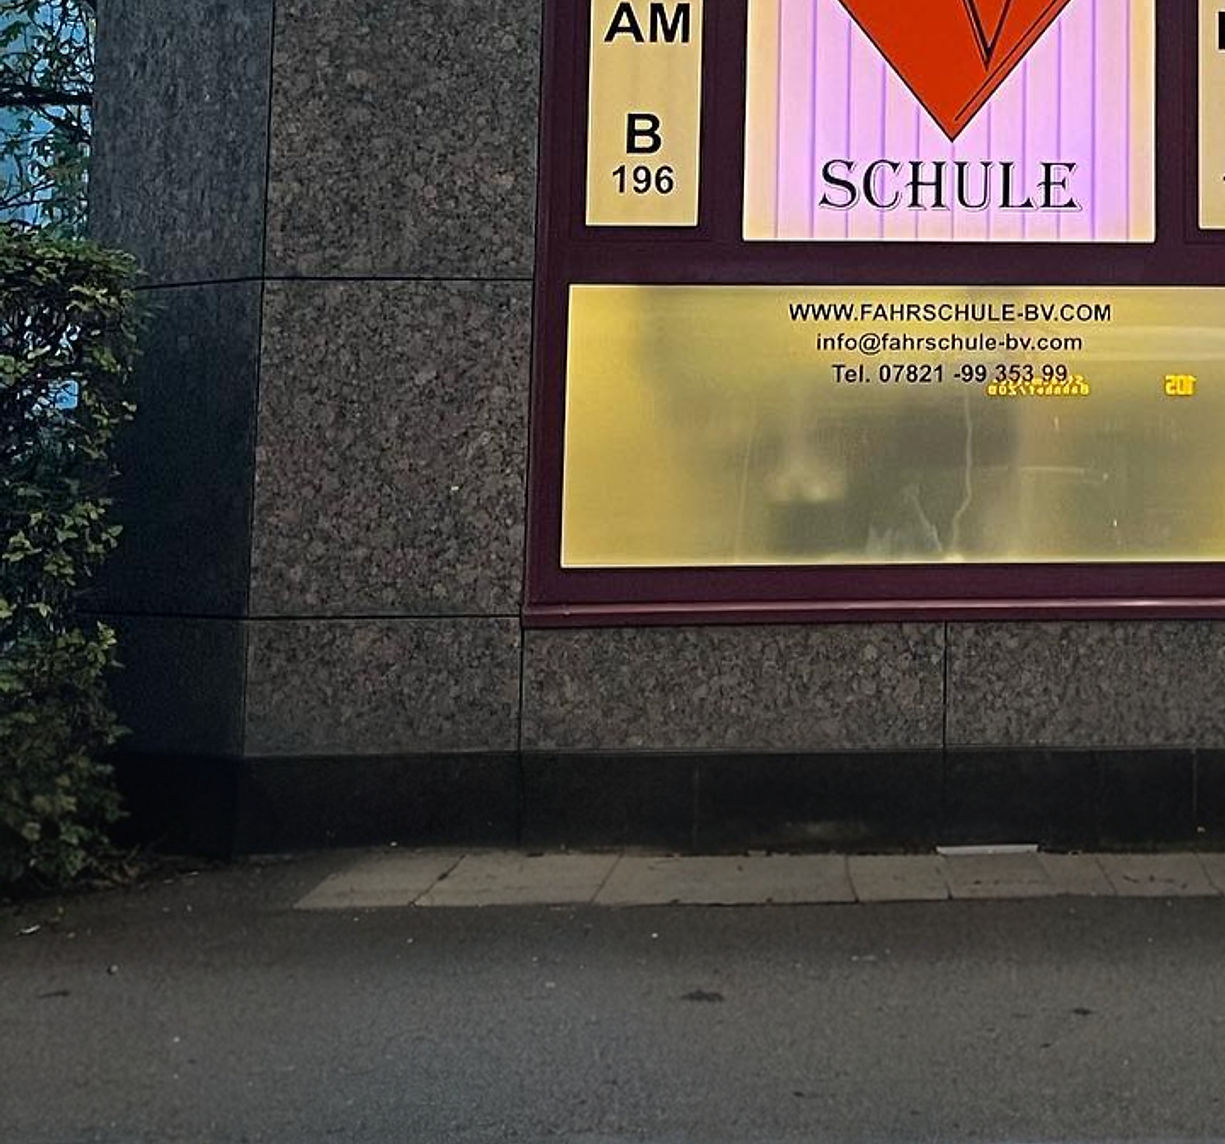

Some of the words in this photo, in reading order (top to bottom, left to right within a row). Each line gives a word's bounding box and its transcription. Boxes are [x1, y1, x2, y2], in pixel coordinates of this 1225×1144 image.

[605, 3, 689, 42] AM
[627, 114, 661, 153] B
[613, 166, 673, 193] 196
[819, 160, 1080, 210] SCHULE
[790, 304, 1110, 321] WWW.FAHRSCHULE-BV.COM
[817, 333, 1081, 354] info@fahrschule-bv.com
[832, 365, 870, 382] Tel.
[880, 365, 942, 382] 07821
[954, 365, 986, 382] -99
[996, 365, 1033, 382] 353
[1043, 365, 1066, 381] 99
